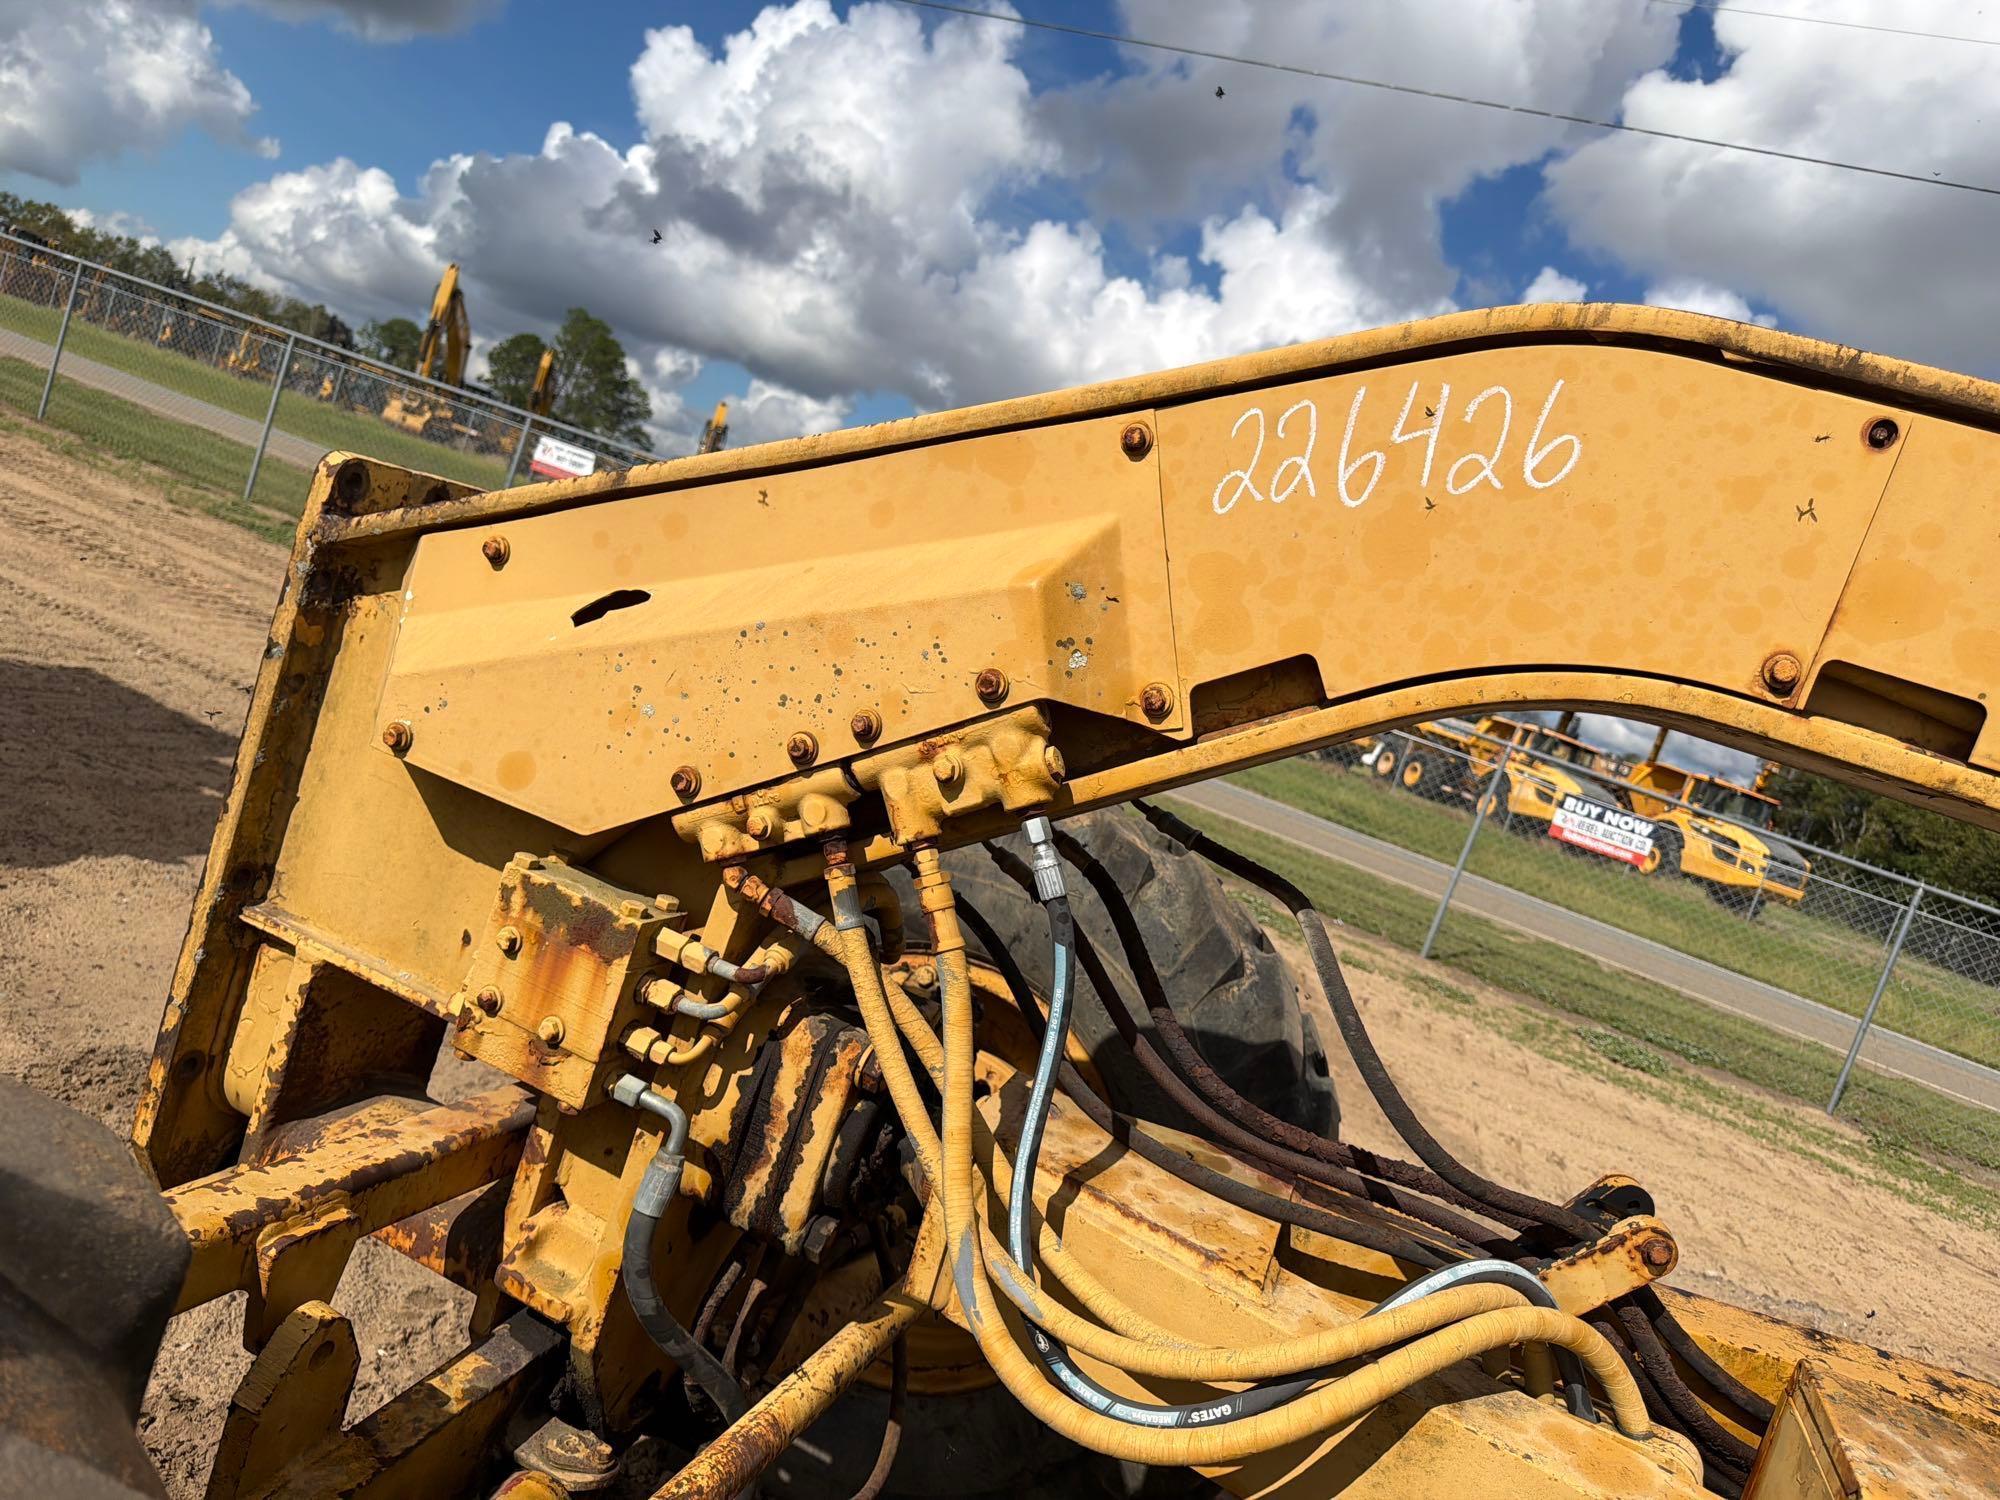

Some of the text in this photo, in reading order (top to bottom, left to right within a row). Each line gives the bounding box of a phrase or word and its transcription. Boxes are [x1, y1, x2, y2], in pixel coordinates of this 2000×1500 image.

[1212, 379, 1583, 515] 226426
[1562, 796, 1602, 819] BUY
[1603, 810, 1654, 837] NOW
